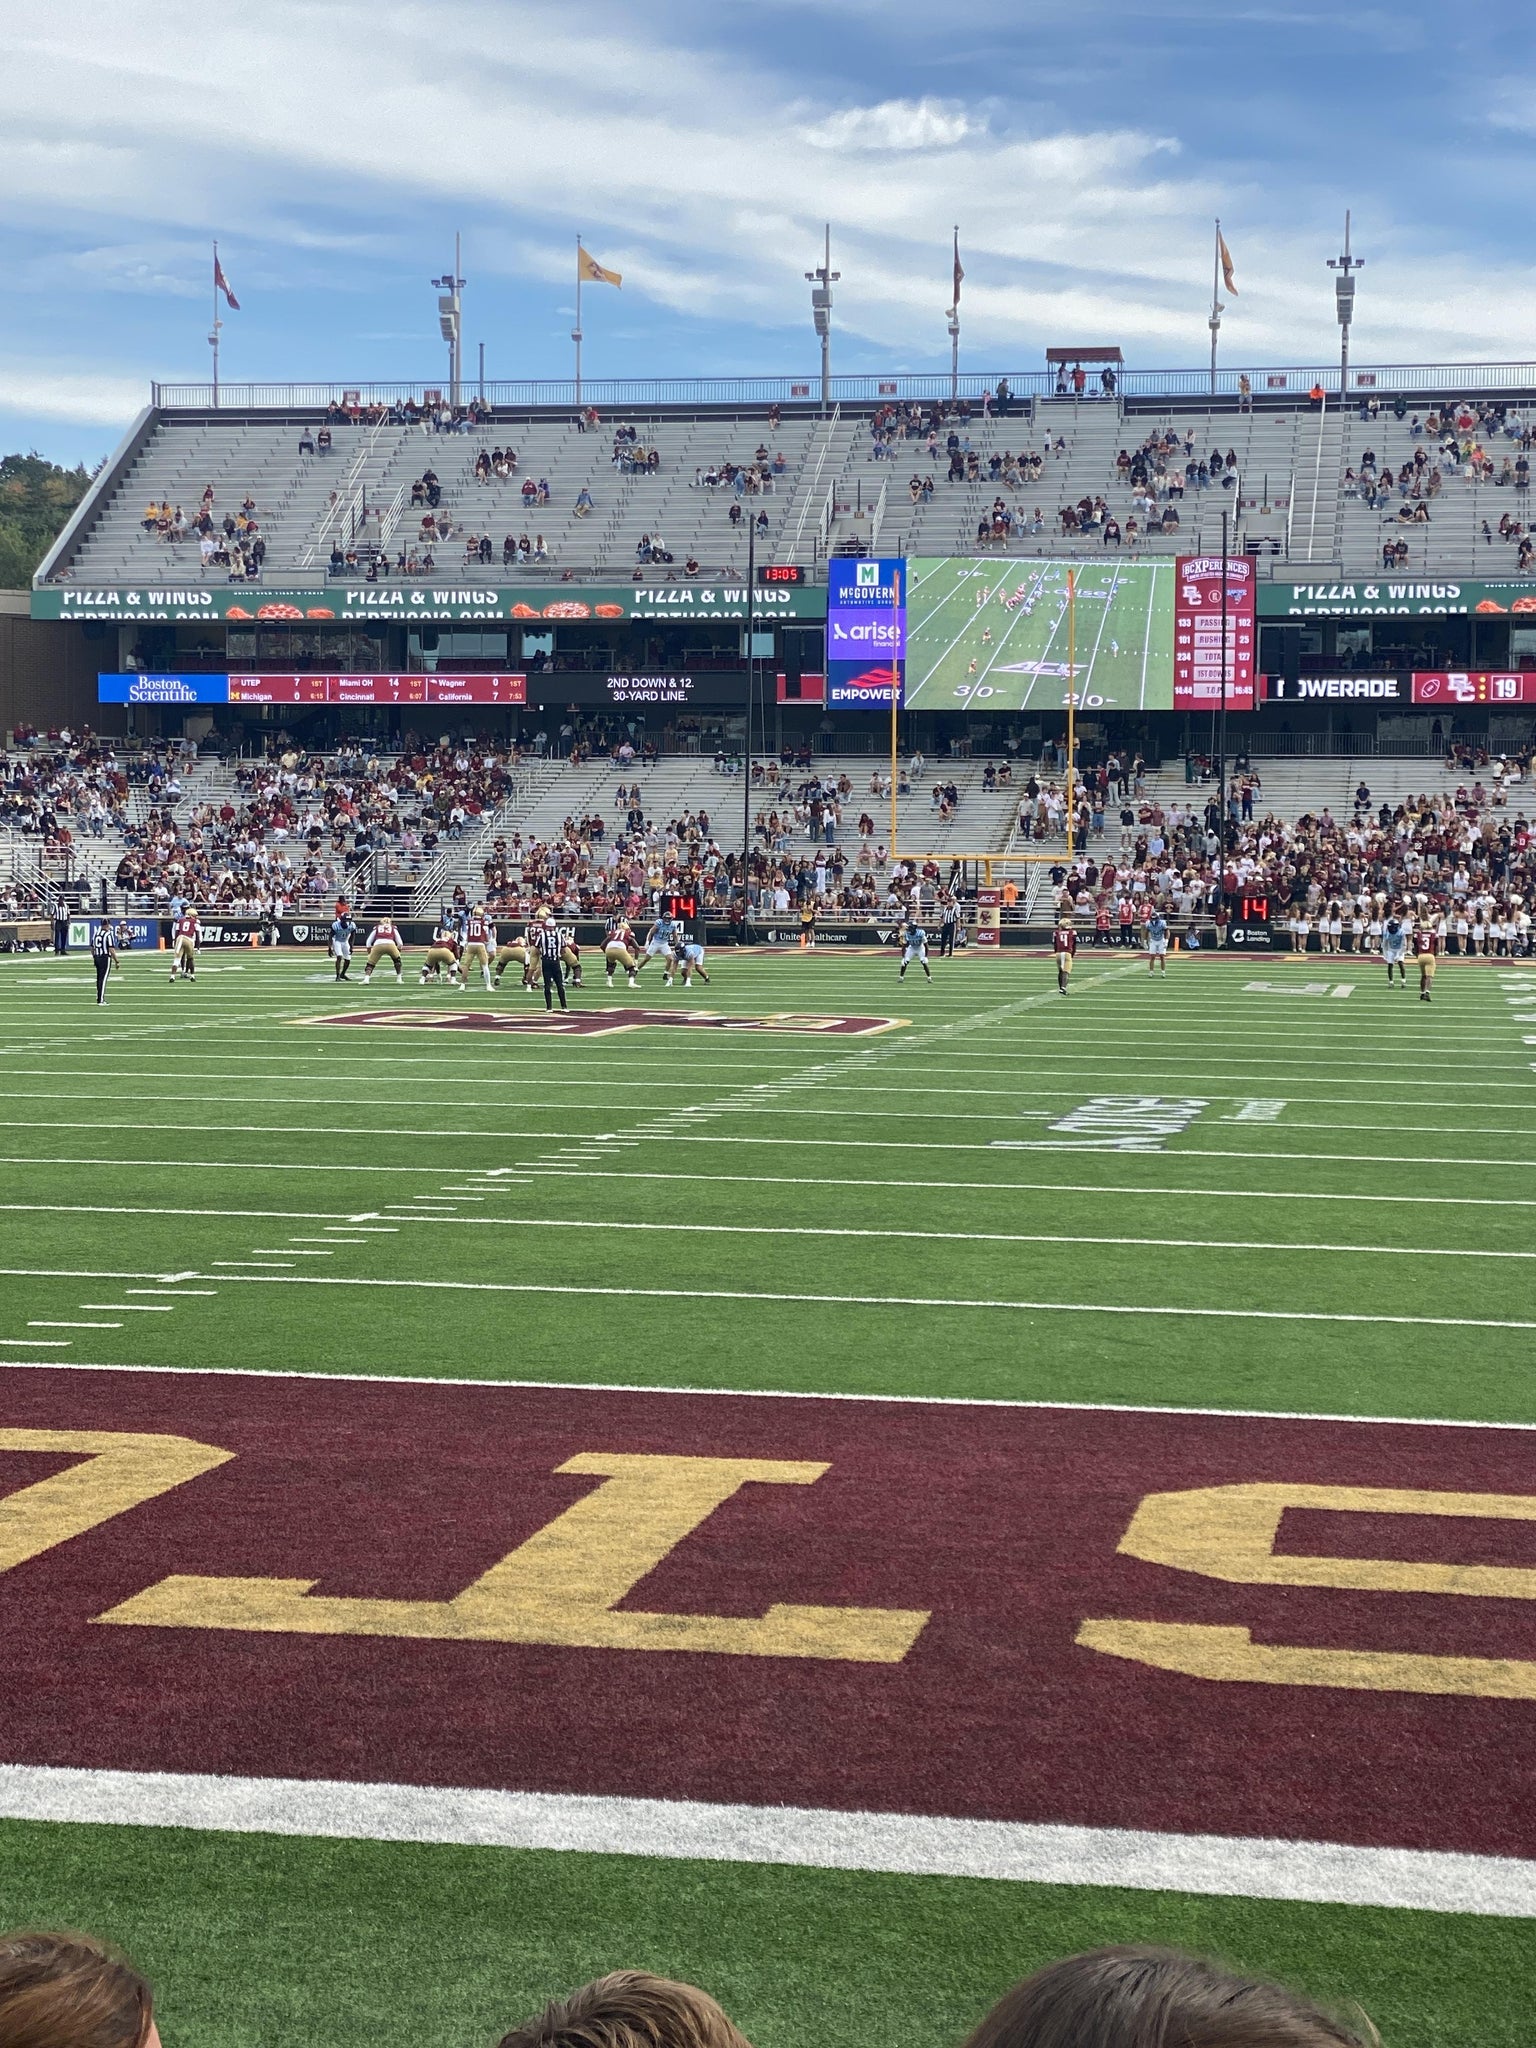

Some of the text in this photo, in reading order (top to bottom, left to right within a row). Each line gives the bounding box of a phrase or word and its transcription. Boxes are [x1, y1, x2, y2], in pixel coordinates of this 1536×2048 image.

[766, 569, 798, 580] 13:05
[346, 591, 498, 604] PIZZA & WINGS
[635, 590, 791, 603] PIZZA & WINGS
[1293, 585, 1461, 599] PIZZA & WINGS
[63, 592, 212, 605] PIZZA & WINGS
[1200, 619, 1231, 627] PASSIG
[849, 621, 901, 640] arise
[1199, 635, 1231, 643] RUSHIG
[139, 676, 181, 690] Boston
[294, 678, 300, 686] 7
[389, 678, 399, 686] 14
[439, 680, 466, 688] Wagner
[493, 678, 499, 686] 0
[607, 678, 694, 688] 2ND DOWN & 12.
[129, 685, 197, 701] Scientific
[832, 689, 900, 700] EMPOWER
[1495, 679, 1516, 698] 19
[241, 693, 272, 701] Michigan
[294, 692, 300, 700] 0
[393, 692, 399, 700] 7
[439, 693, 472, 701] California
[493, 692, 499, 700] 7
[613, 691, 688, 701] 30-YARD LINE.
[671, 898, 695, 918] 14
[1244, 899, 1267, 920] 14
[182, 921, 190, 932] 8
[470, 923, 481, 937] 10
[73, 926, 86, 943] M
[613, 931, 626, 940] 71
[1060, 934, 1068, 947] 4
[547, 936, 557, 948] R
[1421, 937, 1430, 950] 3
